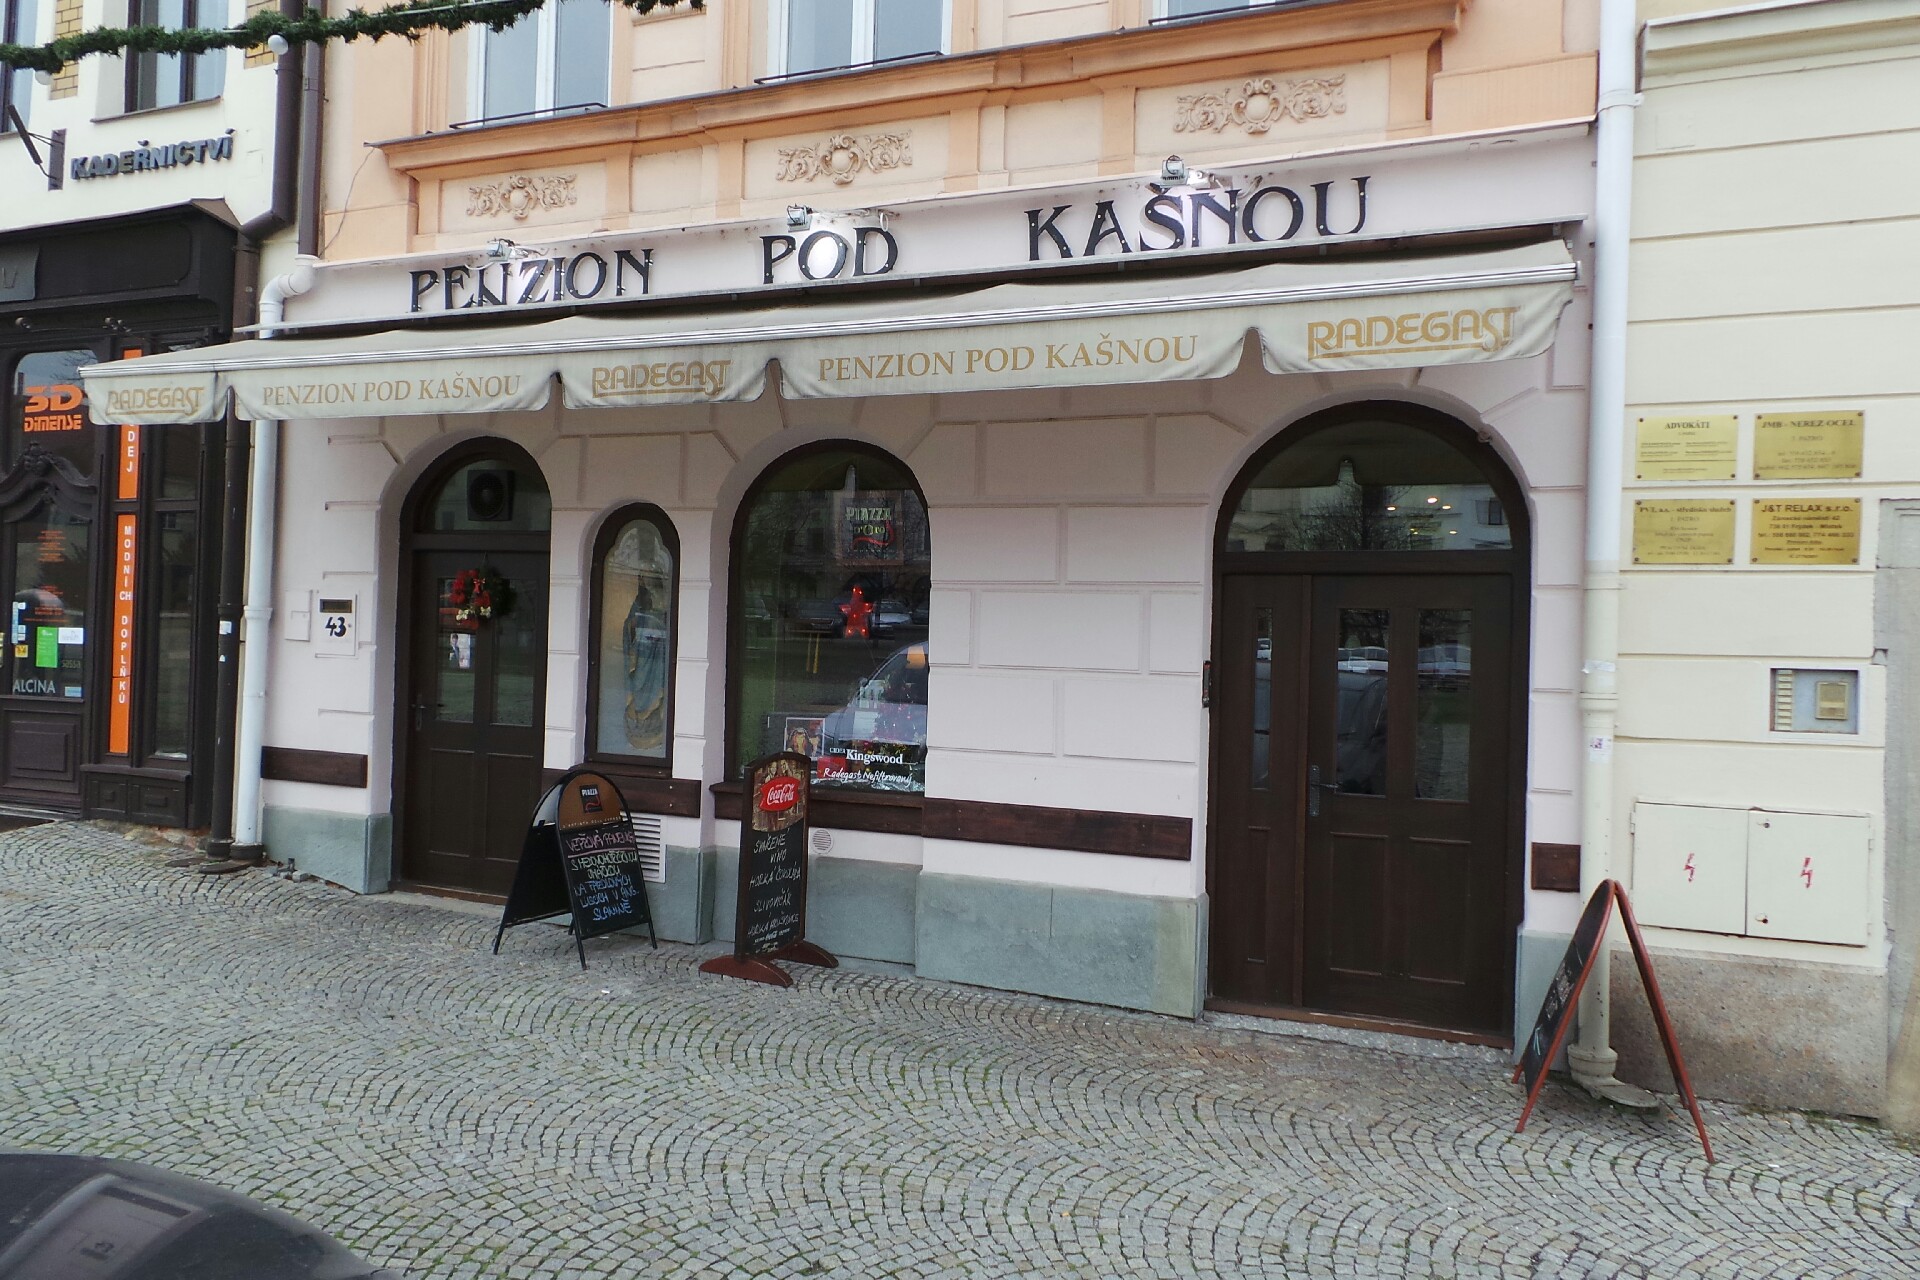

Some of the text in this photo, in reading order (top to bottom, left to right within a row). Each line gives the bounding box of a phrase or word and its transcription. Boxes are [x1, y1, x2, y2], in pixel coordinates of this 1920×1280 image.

[70, 127, 235, 181] KADEŘNICTVÍ
[409, 175, 1370, 313] PENZION POD KAŠNOU
[1307, 305, 1522, 359] RADEGAST
[817, 332, 1199, 382] PENZION POD KAŠNOU
[262, 371, 521, 407] PENZION POD KAŠNOU
[592, 359, 731, 397] RADEGAST
[106, 385, 205, 415] RADEGAST
[1664, 420, 1711, 430] ADVOKÁTI
[126, 424, 136, 473] DEJ
[845, 506, 892, 521] PIAZZA
[1761, 504, 1782, 513] J&T
[1785, 504, 1823, 513] RELAX
[325, 616, 346, 637] 43
[12, 679, 56, 694] ALCINA
[846, 749, 903, 765] Kingswood
[823, 767, 912, 788] Radegast Nefiltrovaný
